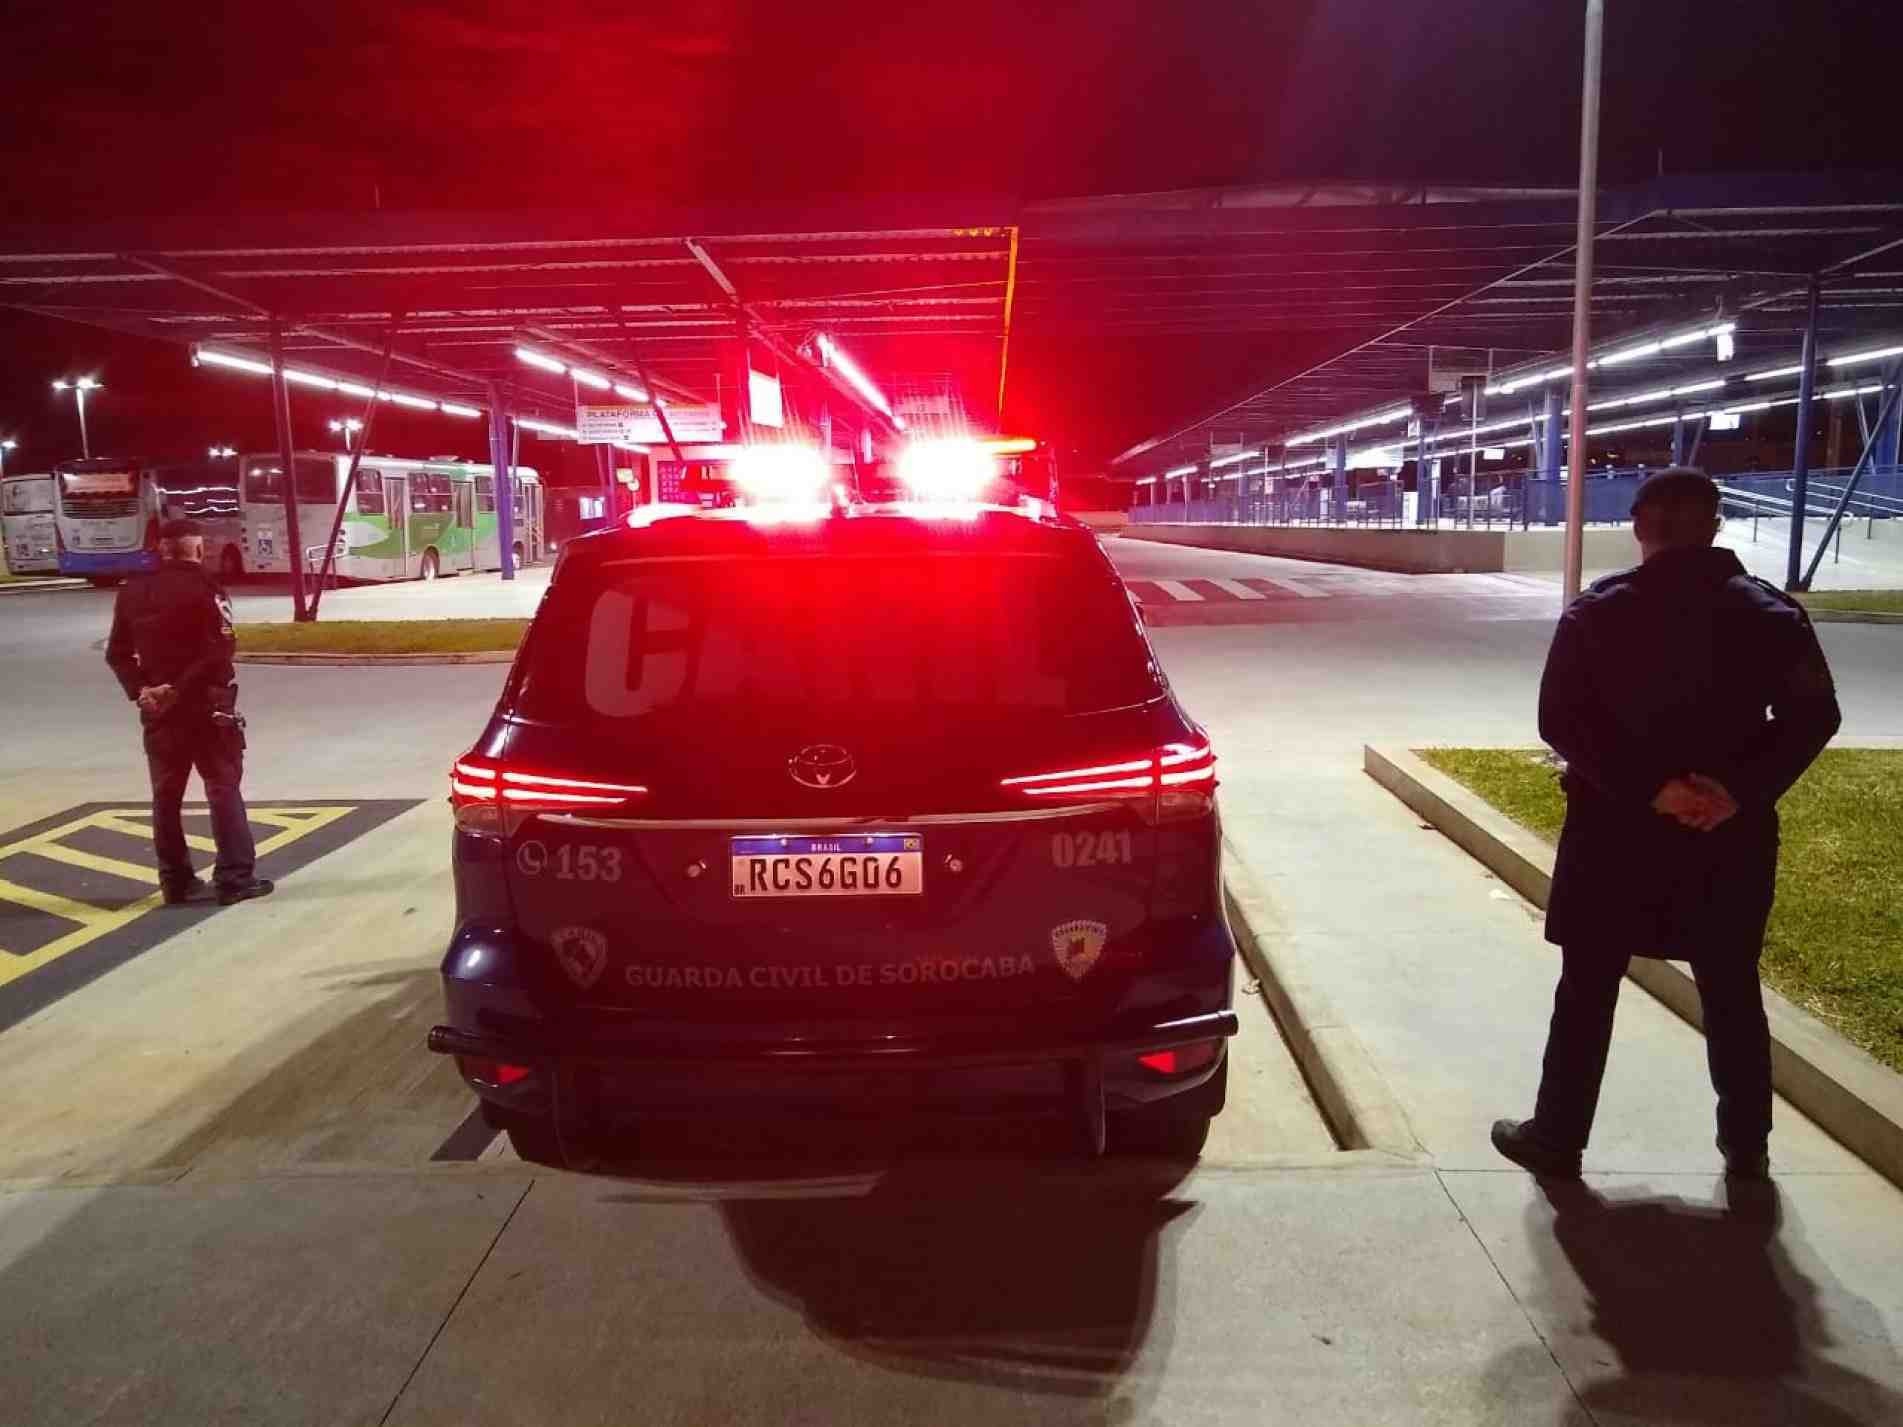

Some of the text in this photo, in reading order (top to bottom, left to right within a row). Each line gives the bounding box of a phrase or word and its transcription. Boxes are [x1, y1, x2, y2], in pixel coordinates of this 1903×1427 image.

[555, 845, 622, 882] 153
[1051, 831, 1133, 867] 0241
[750, 856, 903, 892] RCS6G06
[624, 954, 1035, 989] GUARDA CIVIL DE SOROCABA
